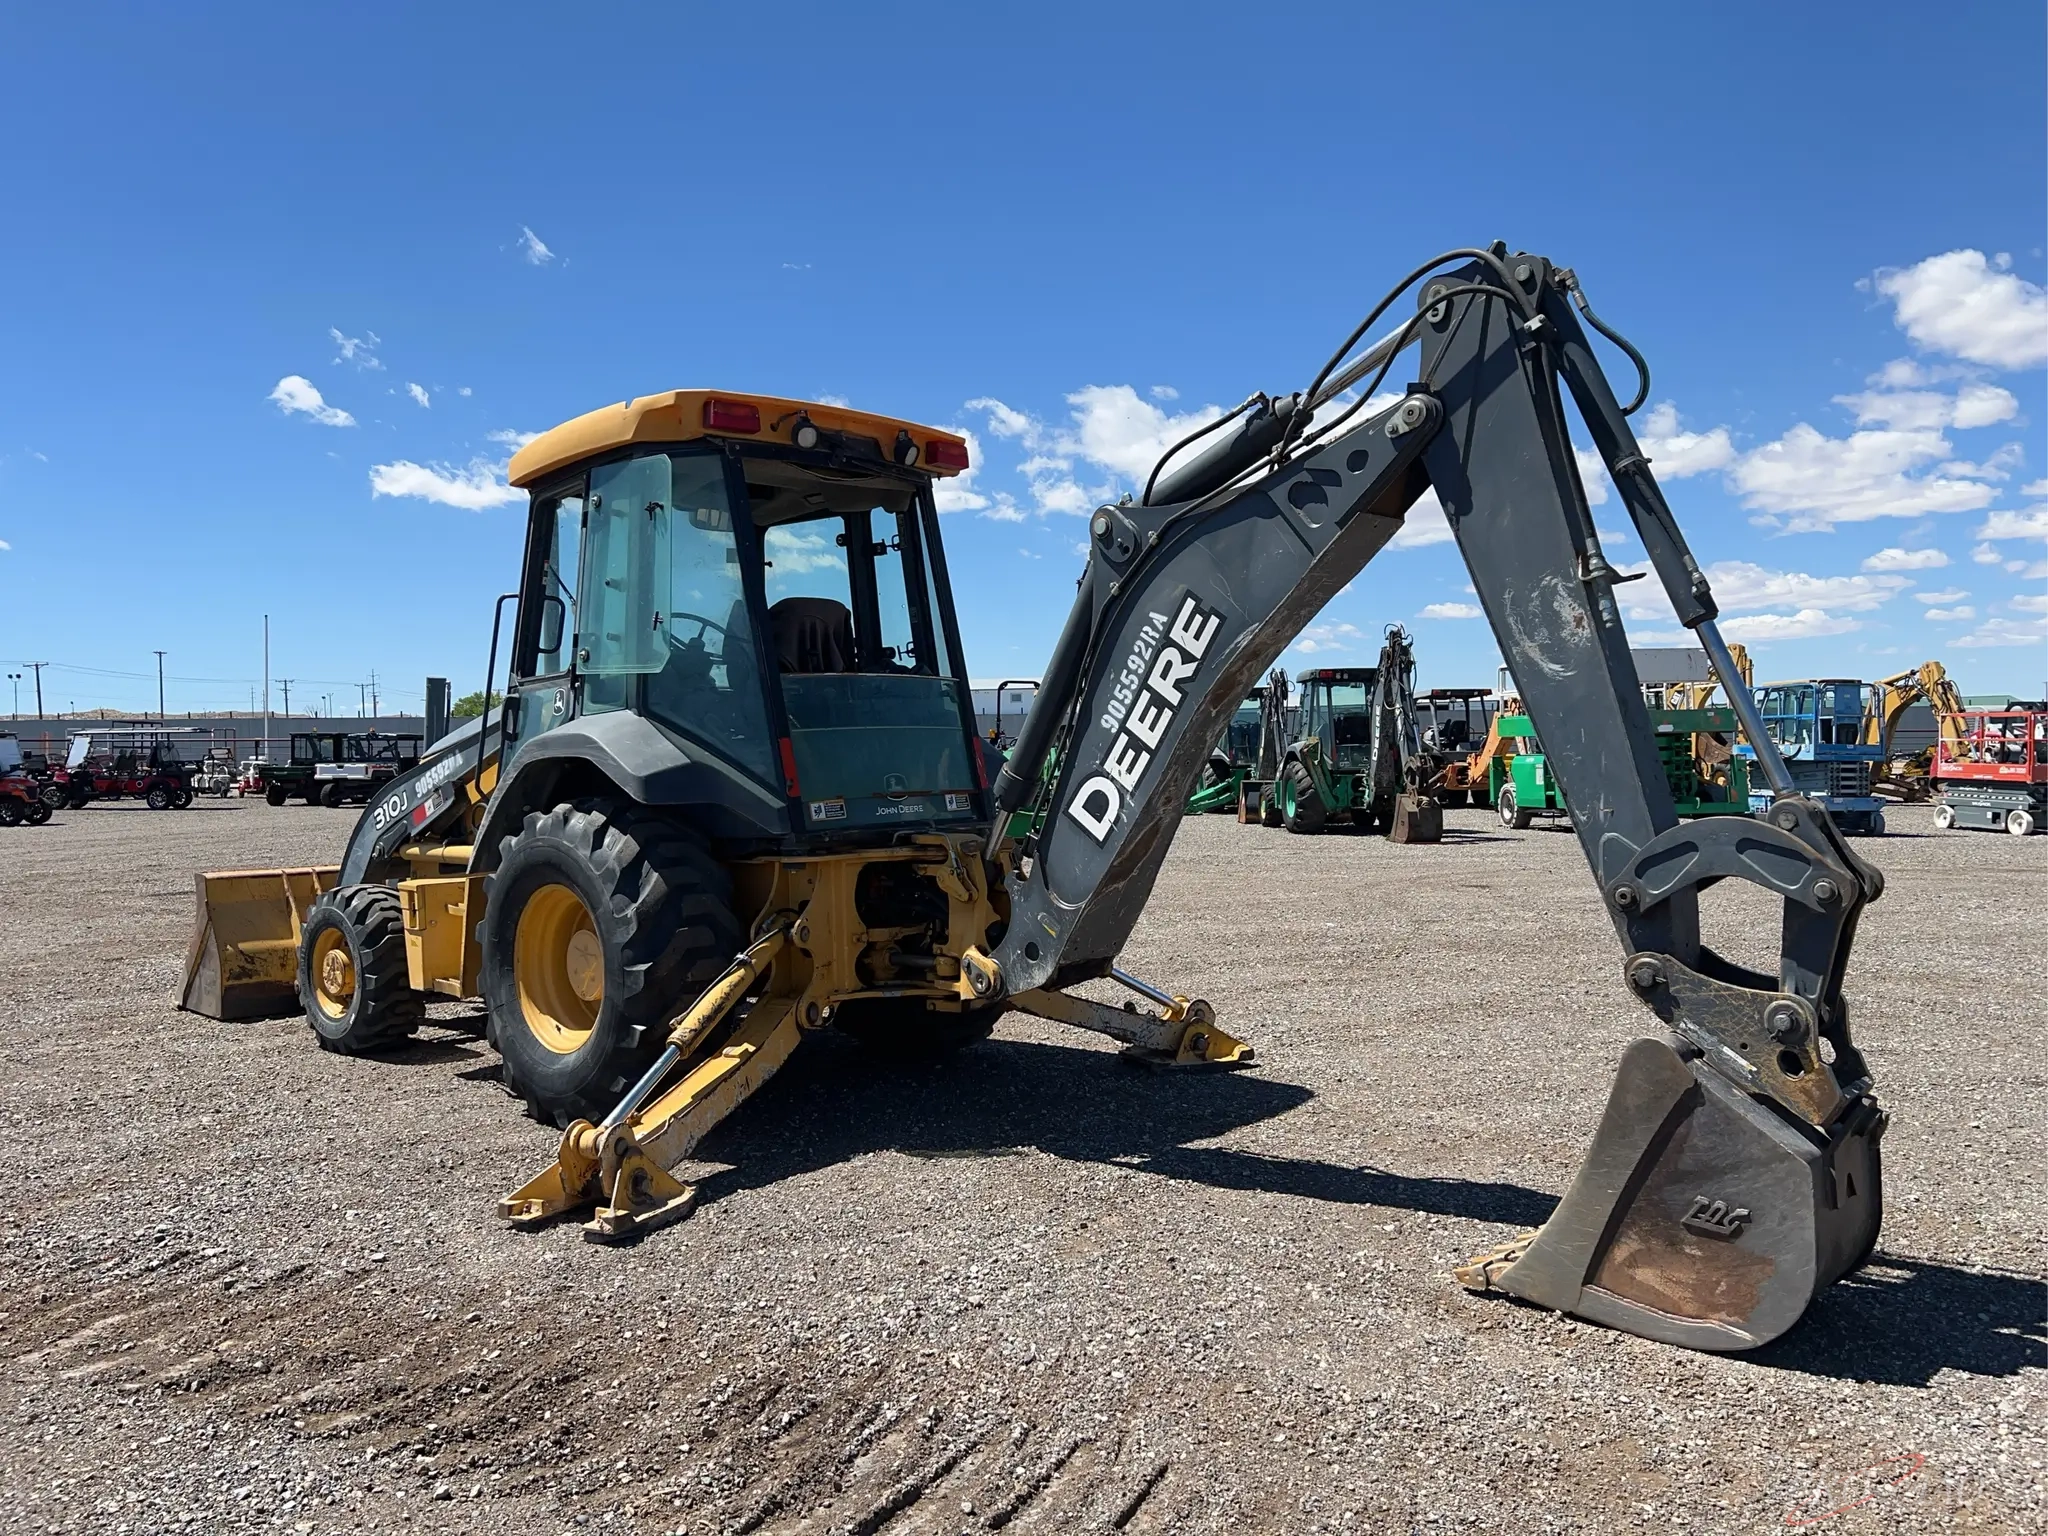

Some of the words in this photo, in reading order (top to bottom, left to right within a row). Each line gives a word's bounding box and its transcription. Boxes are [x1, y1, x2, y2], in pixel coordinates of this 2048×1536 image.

[1100, 611, 1168, 733] 905592RA
[1067, 596, 1220, 842] DEERE
[374, 791, 408, 830] 310J
[876, 806, 898, 816] JOHN
[898, 804, 924, 814] DEERE
